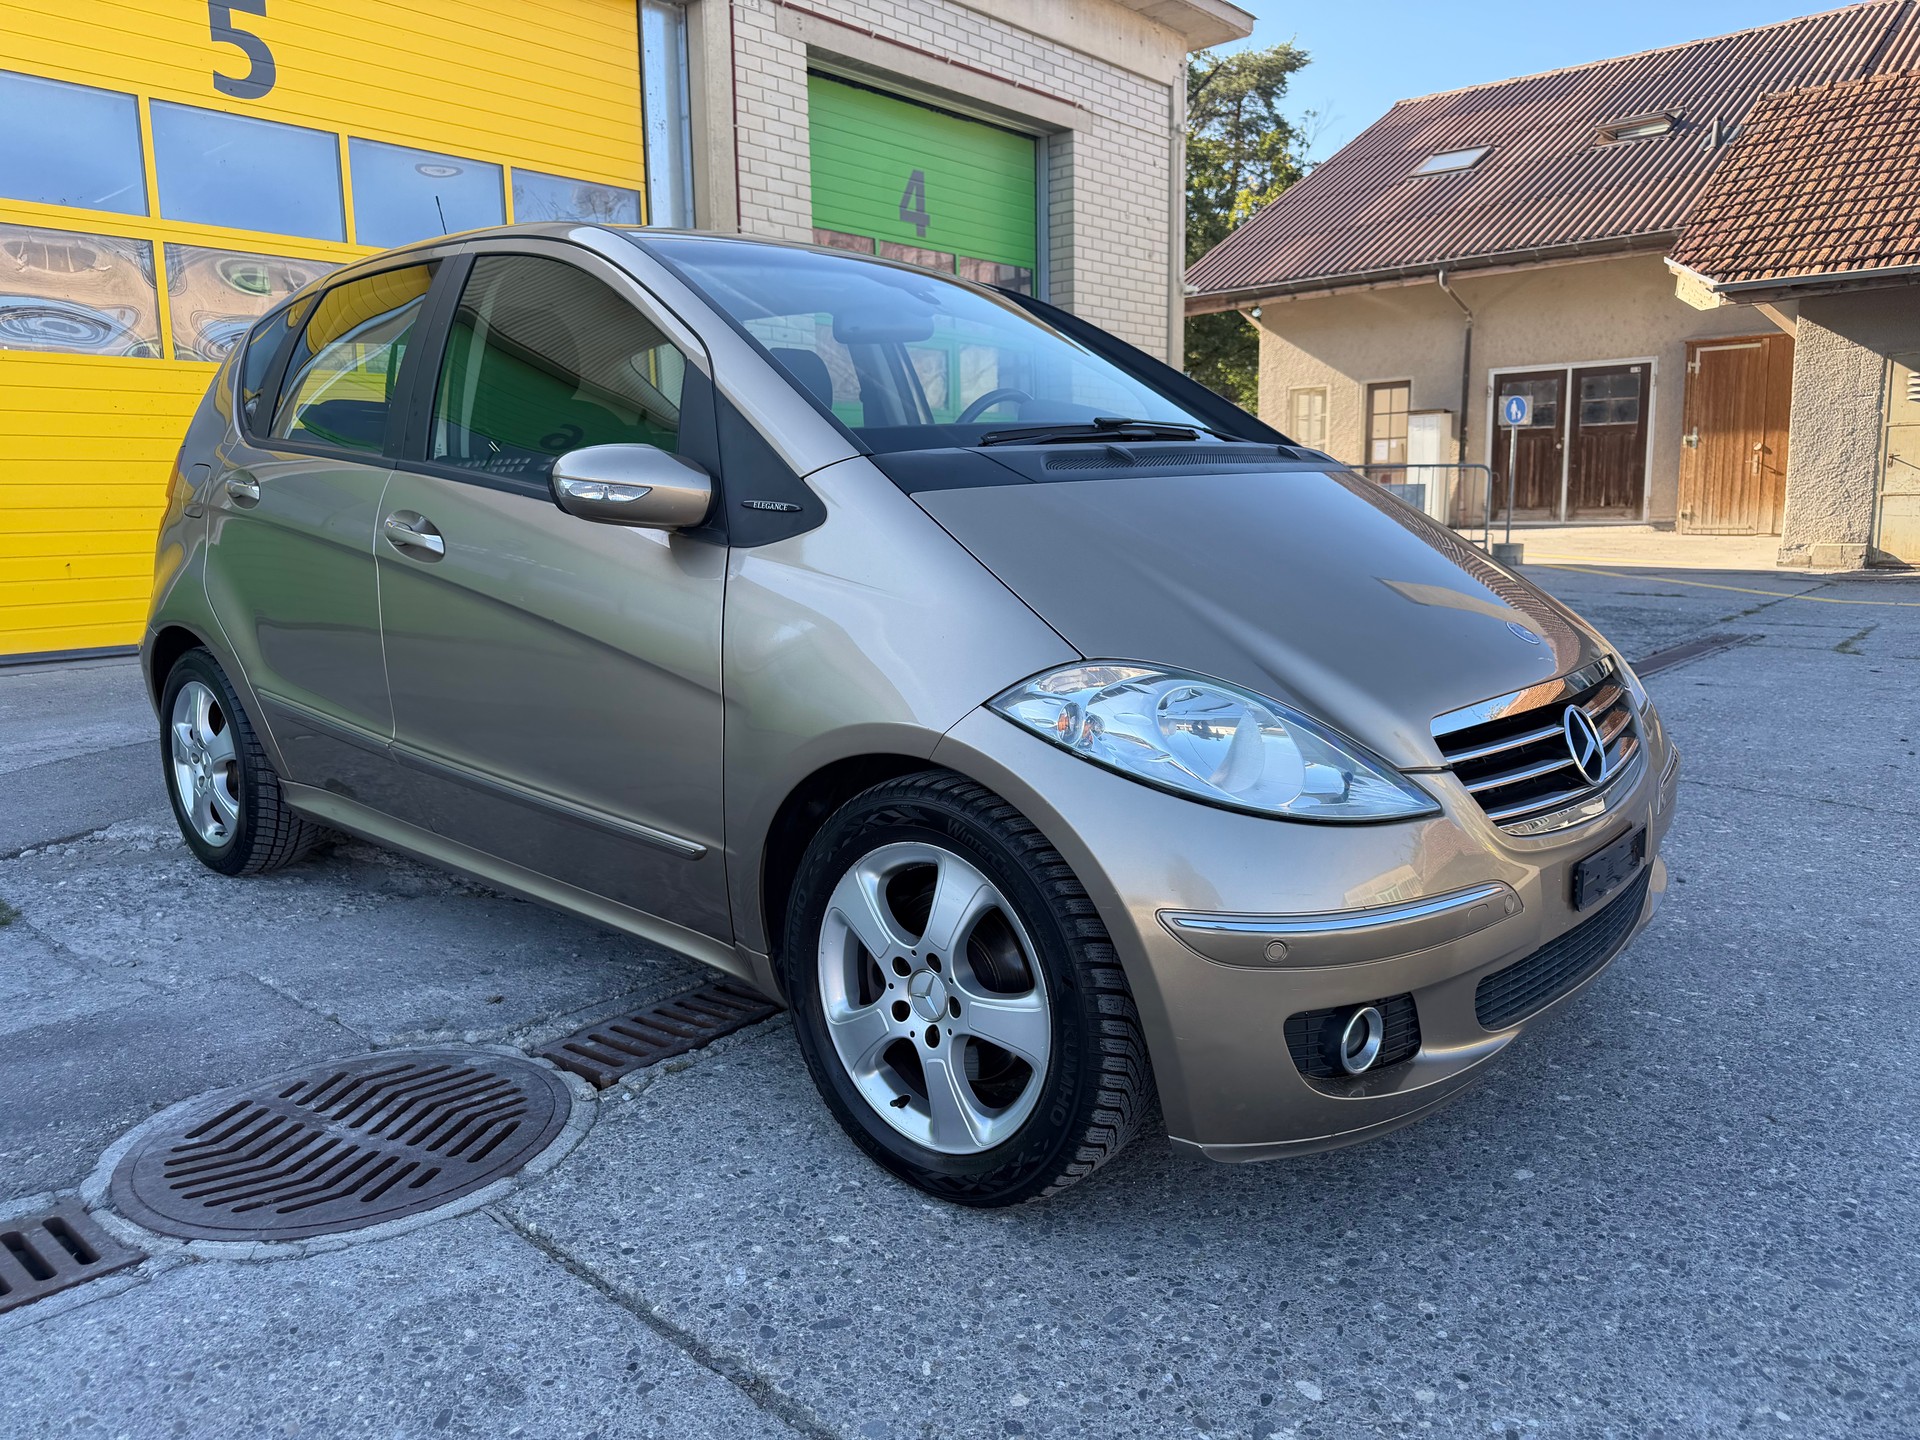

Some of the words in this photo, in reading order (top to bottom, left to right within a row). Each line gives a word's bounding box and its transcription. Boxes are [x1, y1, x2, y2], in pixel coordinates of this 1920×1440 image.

[208, 0, 276, 99] 5
[899, 169, 930, 238] 4
[753, 501, 788, 511] ELEGANCE
[789, 888, 807, 983] KUMHO
[1050, 1022, 1080, 1127] KUMHO
